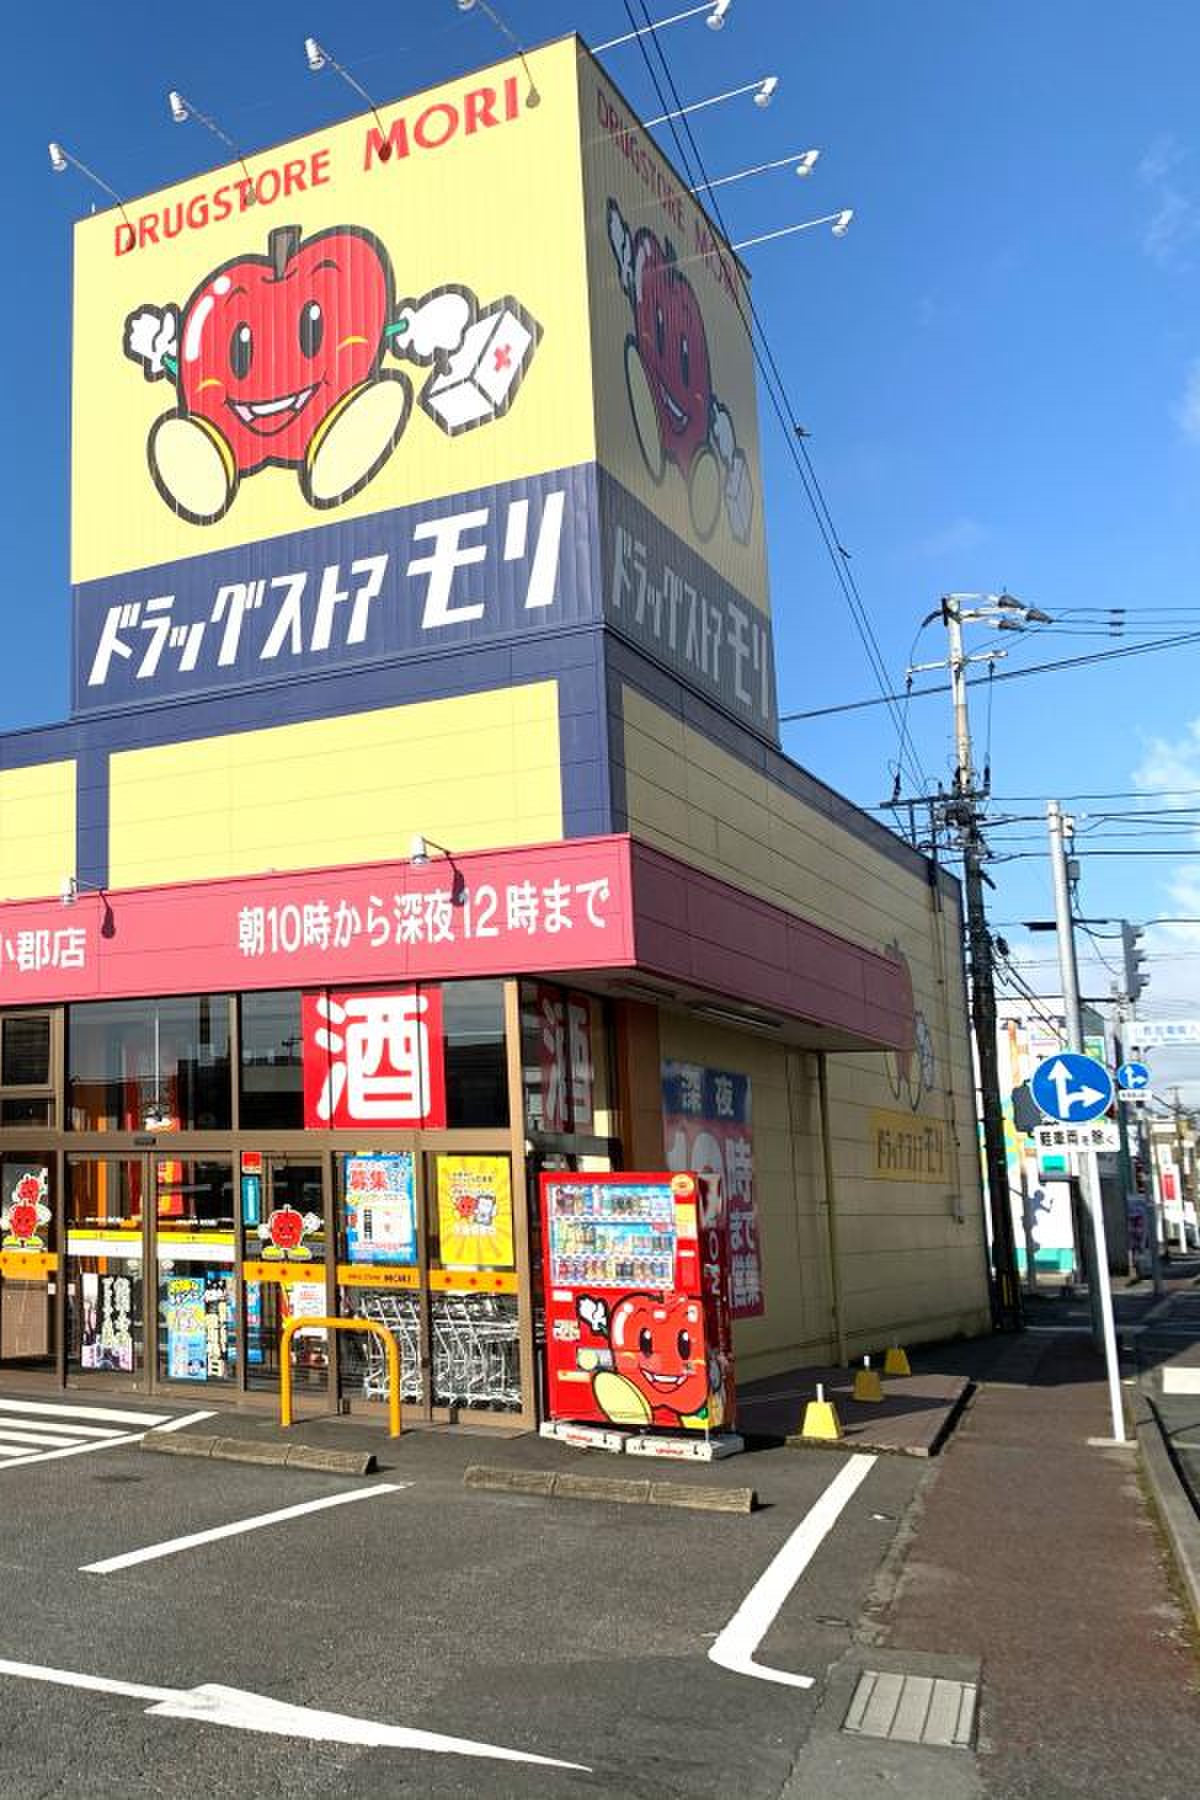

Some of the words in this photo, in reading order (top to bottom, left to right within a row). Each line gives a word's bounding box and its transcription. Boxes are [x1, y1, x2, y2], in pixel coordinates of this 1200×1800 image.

[114, 150, 331, 257] DRUGSTORE
[362, 76, 521, 171] MORI
[238, 876, 611, 957] 朝10時から深夜12時まで
[315, 993, 430, 1121] 酒
[678, 1067, 735, 1117] 深夜
